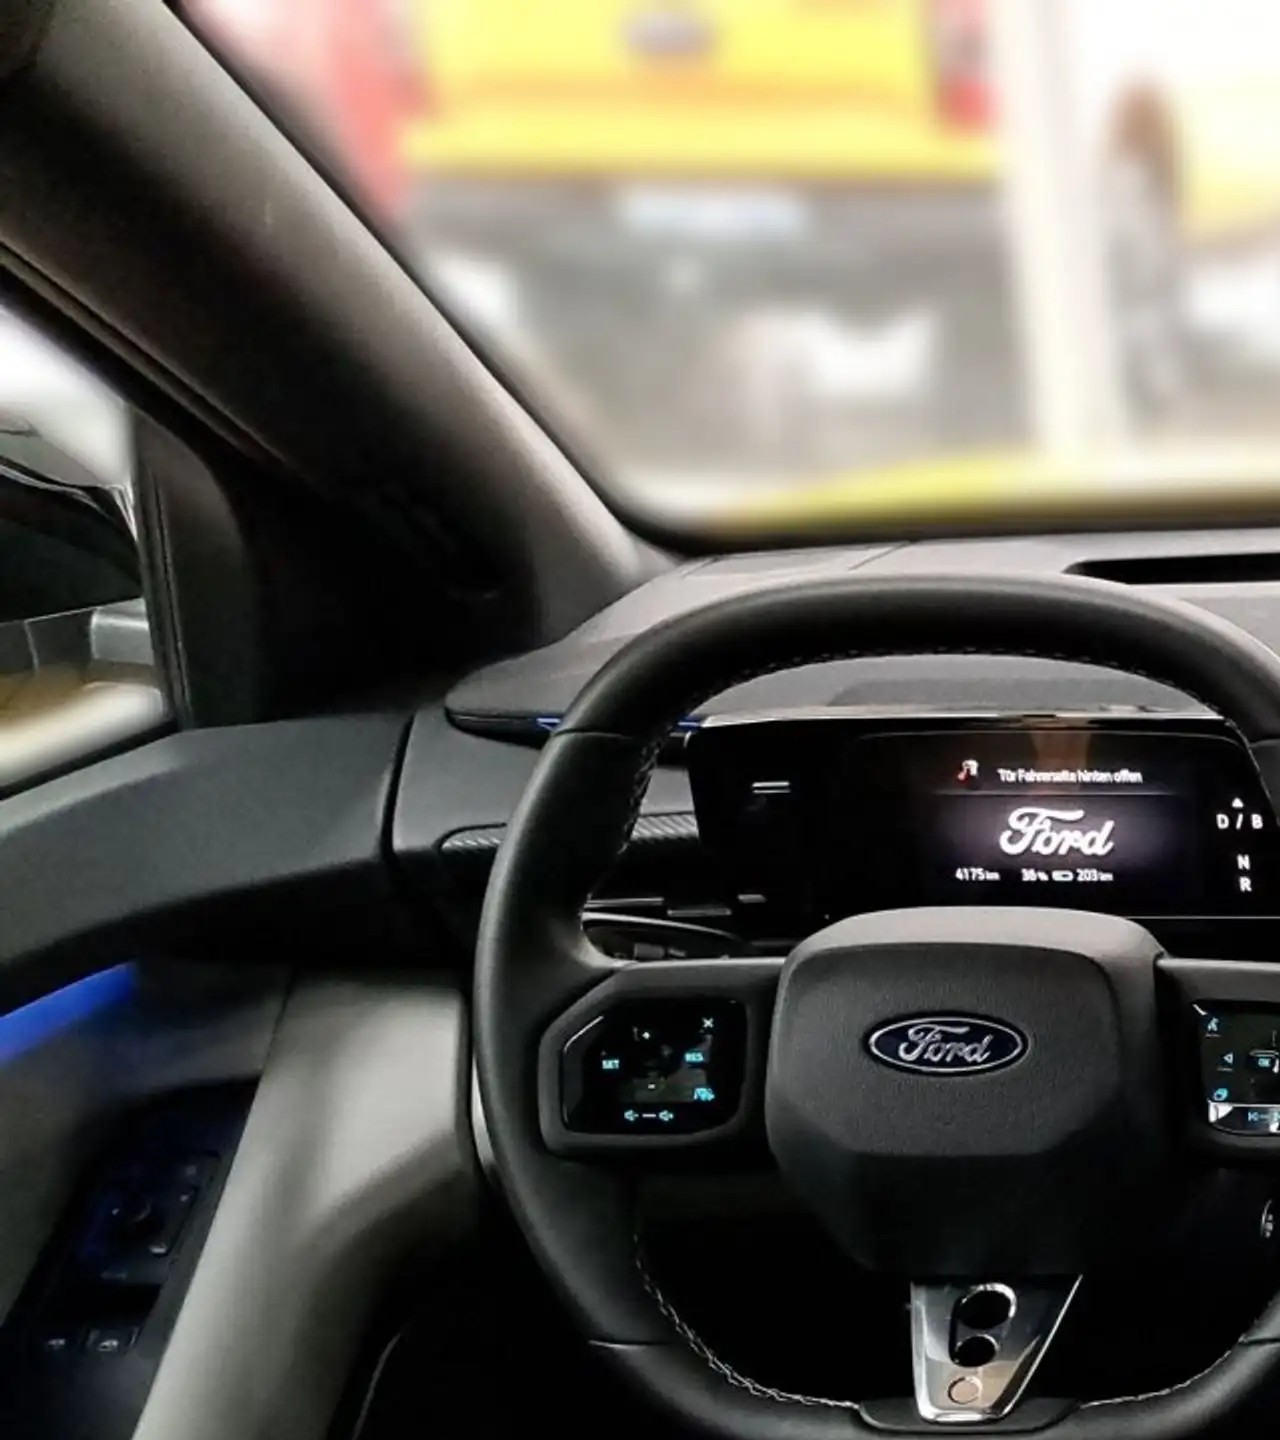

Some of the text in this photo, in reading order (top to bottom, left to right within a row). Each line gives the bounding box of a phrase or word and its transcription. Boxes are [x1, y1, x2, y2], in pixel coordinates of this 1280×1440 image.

[1216, 813, 1229, 830] D
[1251, 813, 1263, 830] B
[999, 806, 1116, 855] Ford
[1237, 853, 1250, 870] N
[1239, 875, 1252, 892] R
[898, 1024, 994, 1062] Ford
